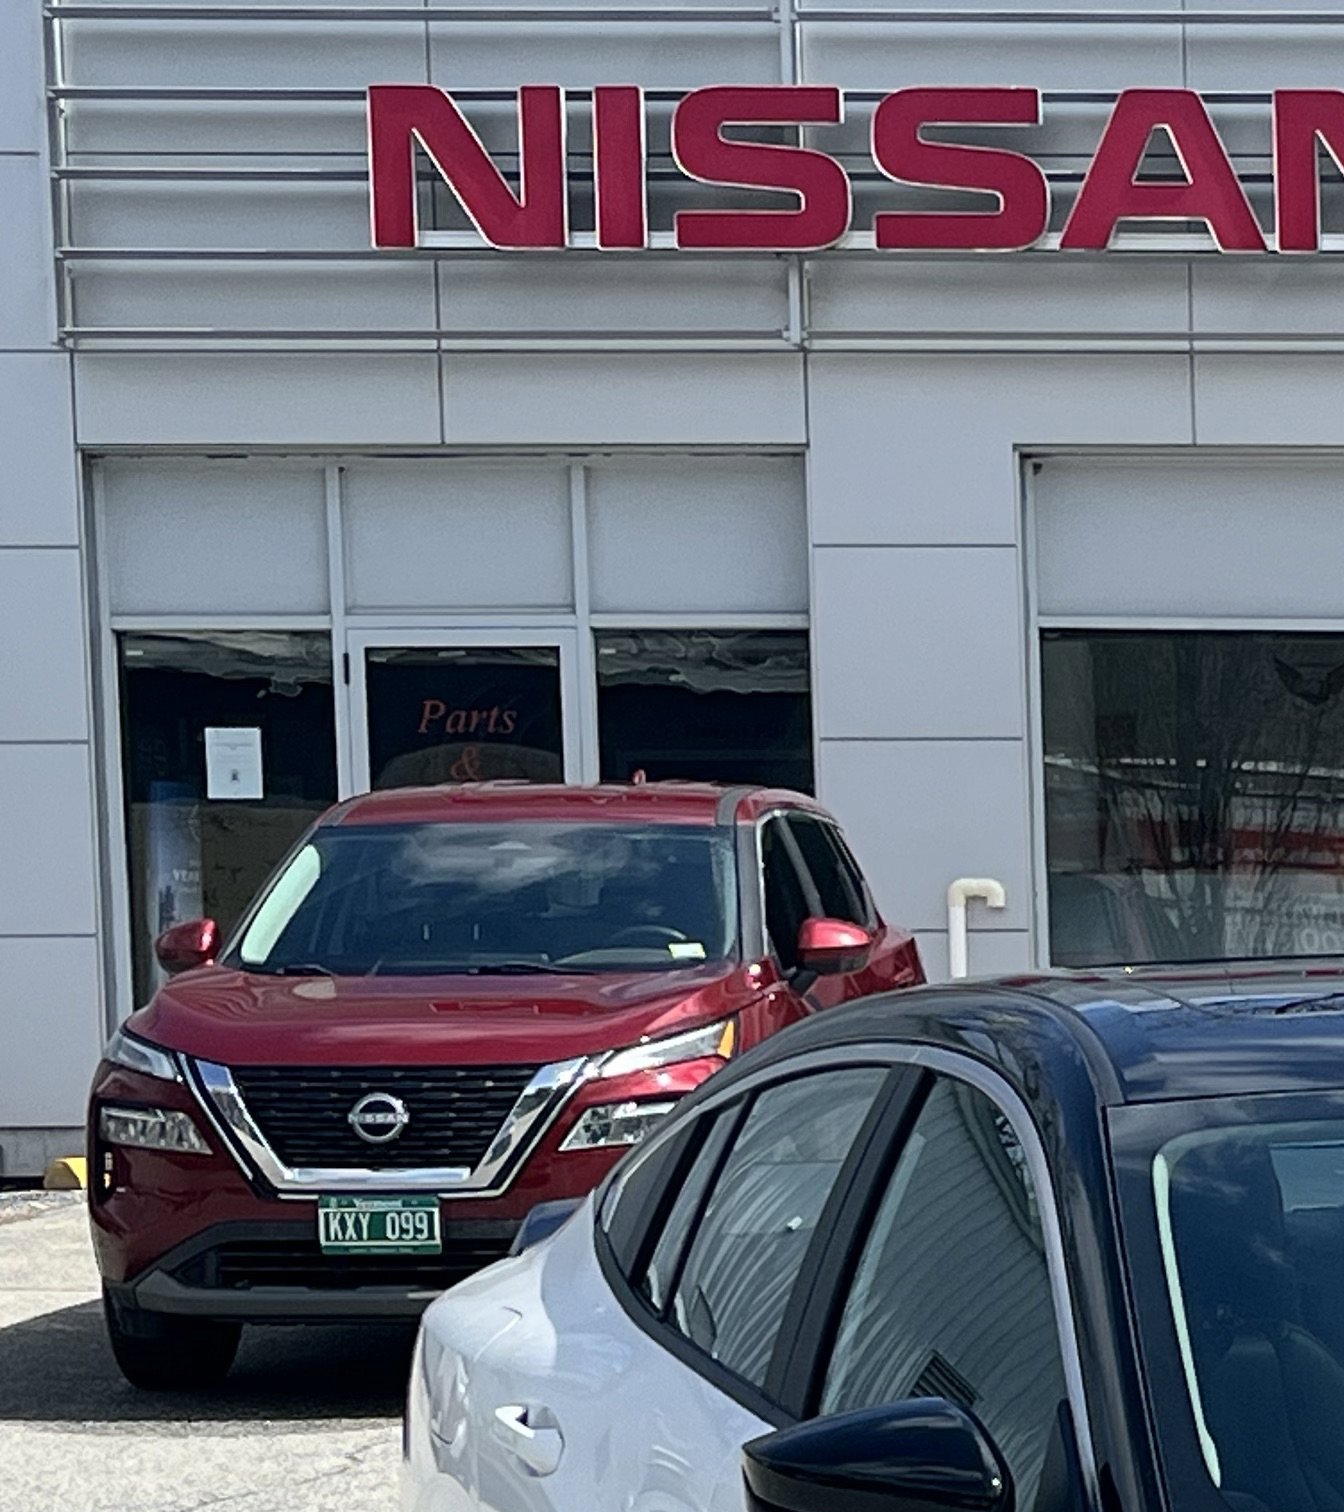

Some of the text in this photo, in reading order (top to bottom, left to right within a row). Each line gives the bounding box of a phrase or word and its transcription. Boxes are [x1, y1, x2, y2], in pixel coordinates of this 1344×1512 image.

[417, 699, 518, 734] Parts
[450, 744, 481, 781] &
[328, 1211, 429, 1241] KXY 099
